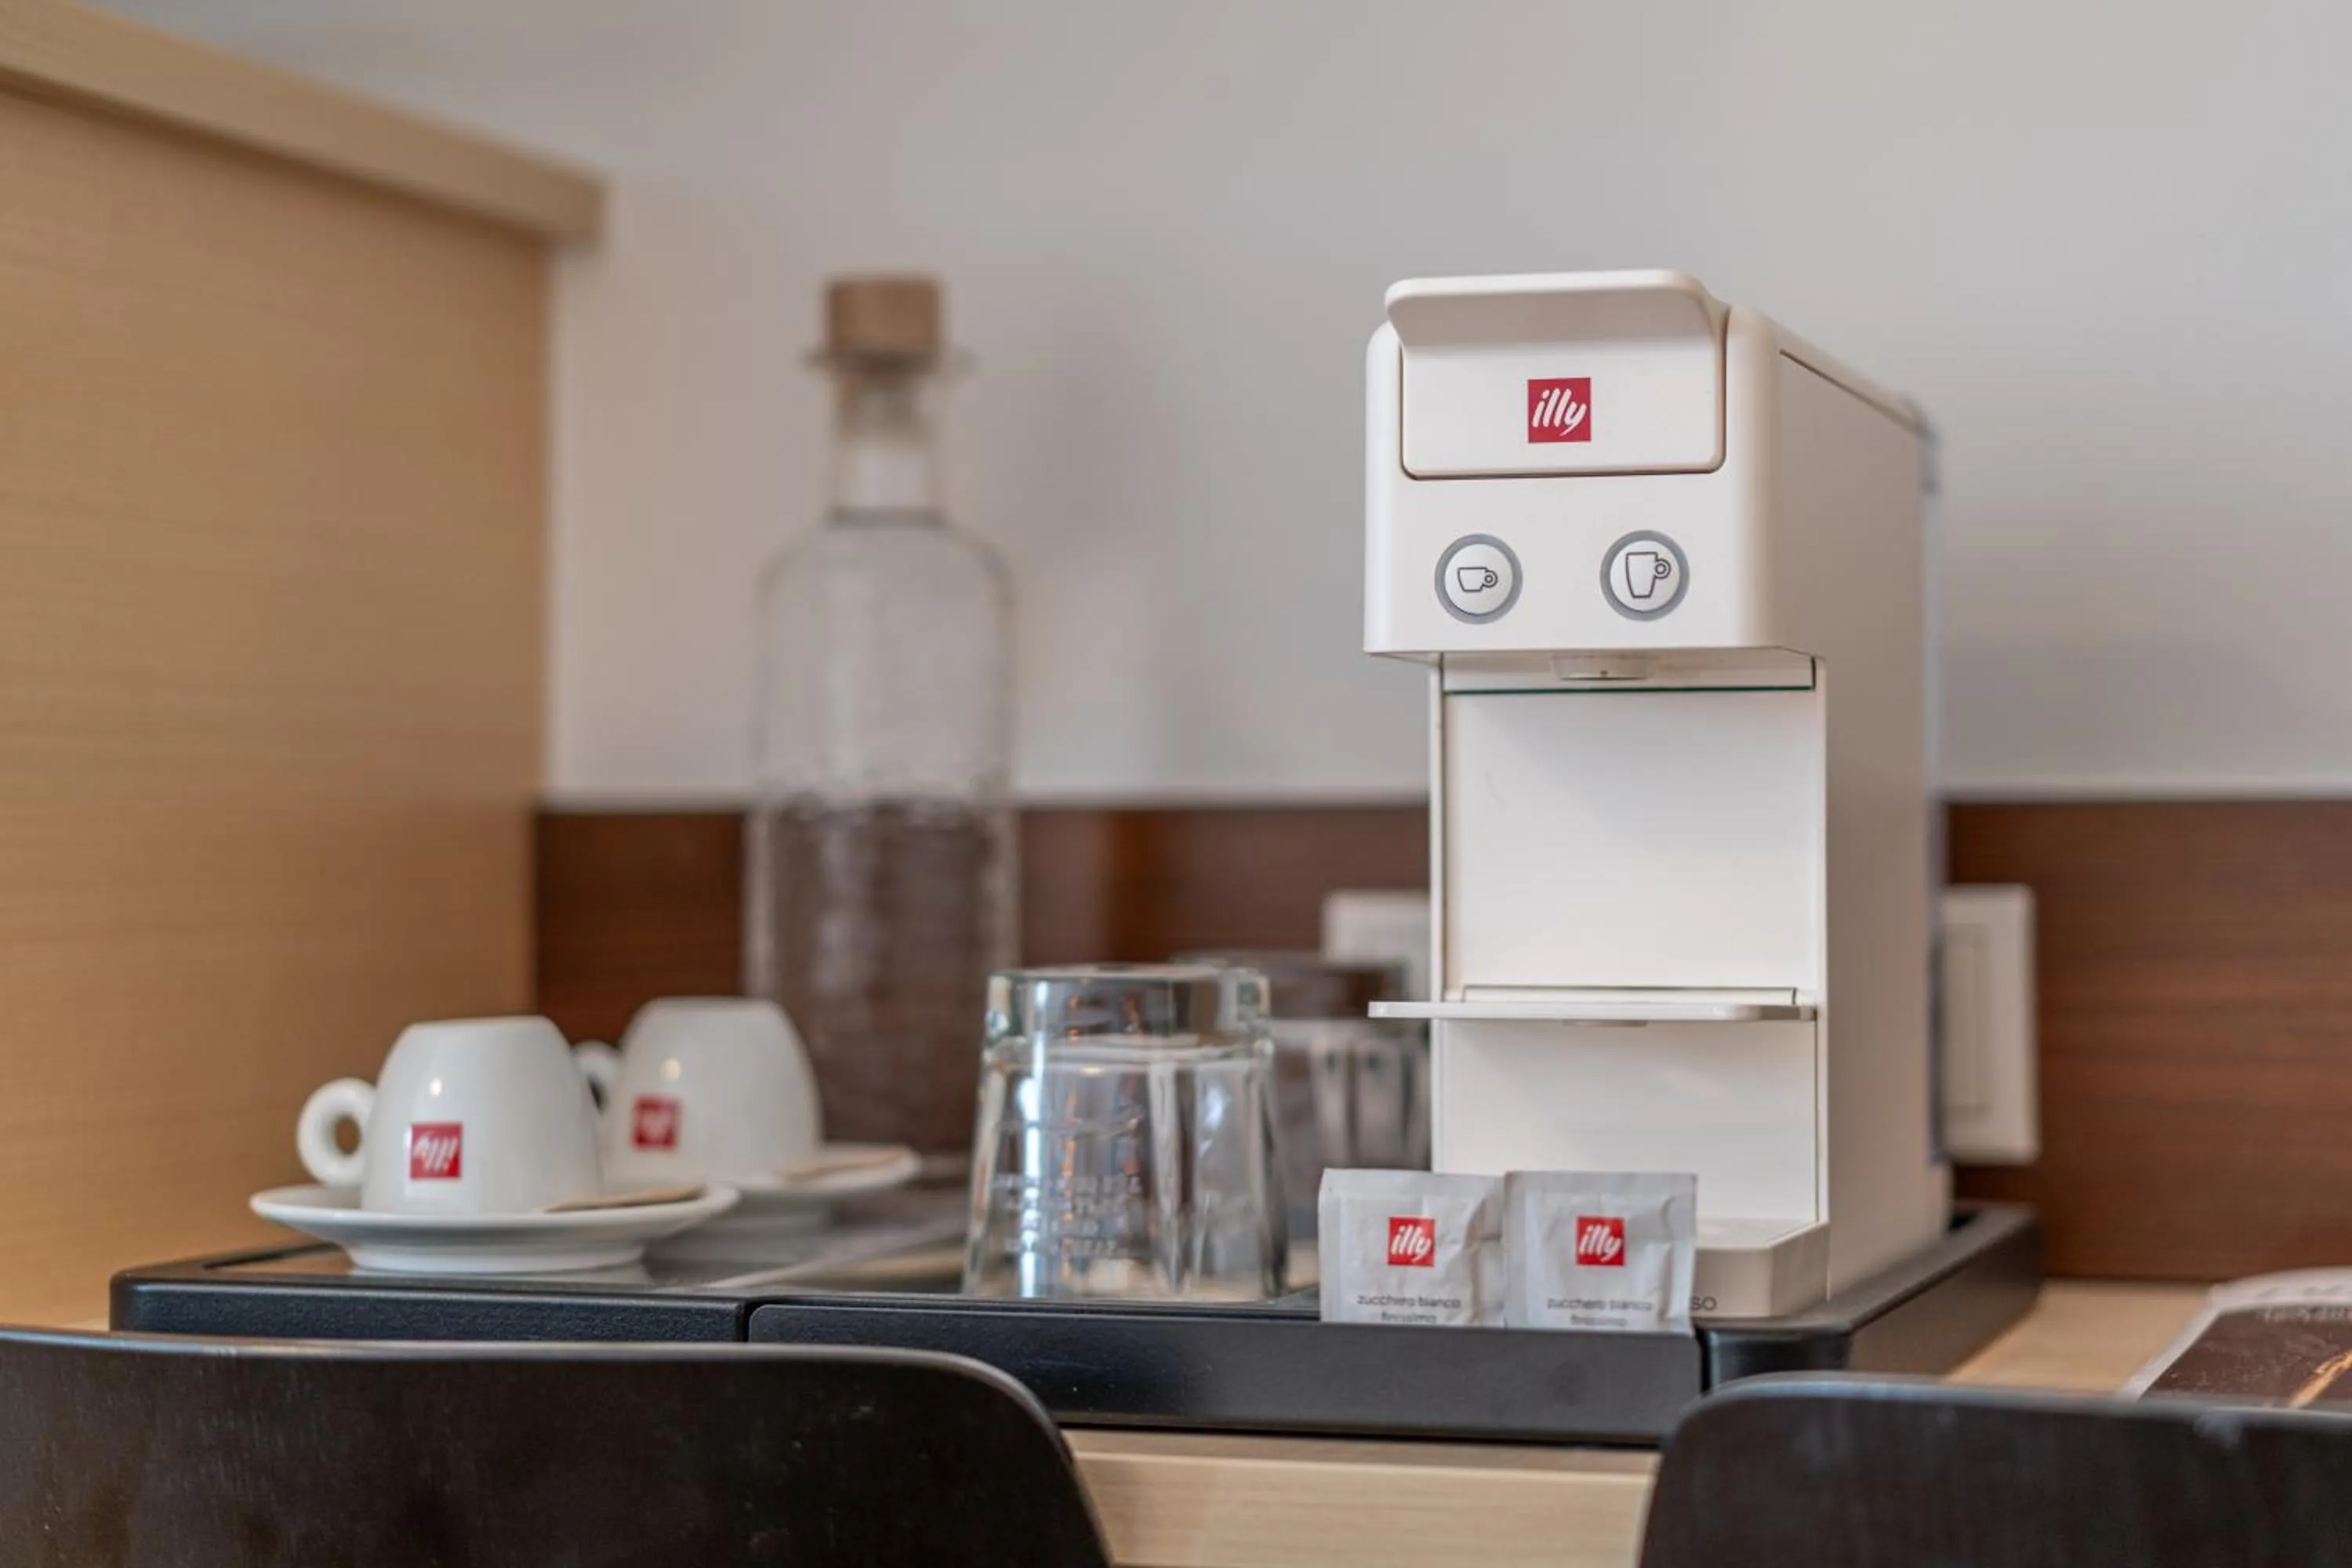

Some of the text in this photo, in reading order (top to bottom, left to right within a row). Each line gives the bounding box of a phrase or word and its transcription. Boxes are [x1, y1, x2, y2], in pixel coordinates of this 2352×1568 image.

[1532, 387, 1588, 437] illy
[1391, 1224, 1432, 1263] illy
[1579, 1223, 1622, 1263] illy
[1357, 1294, 1461, 1308] zucchero bianco
